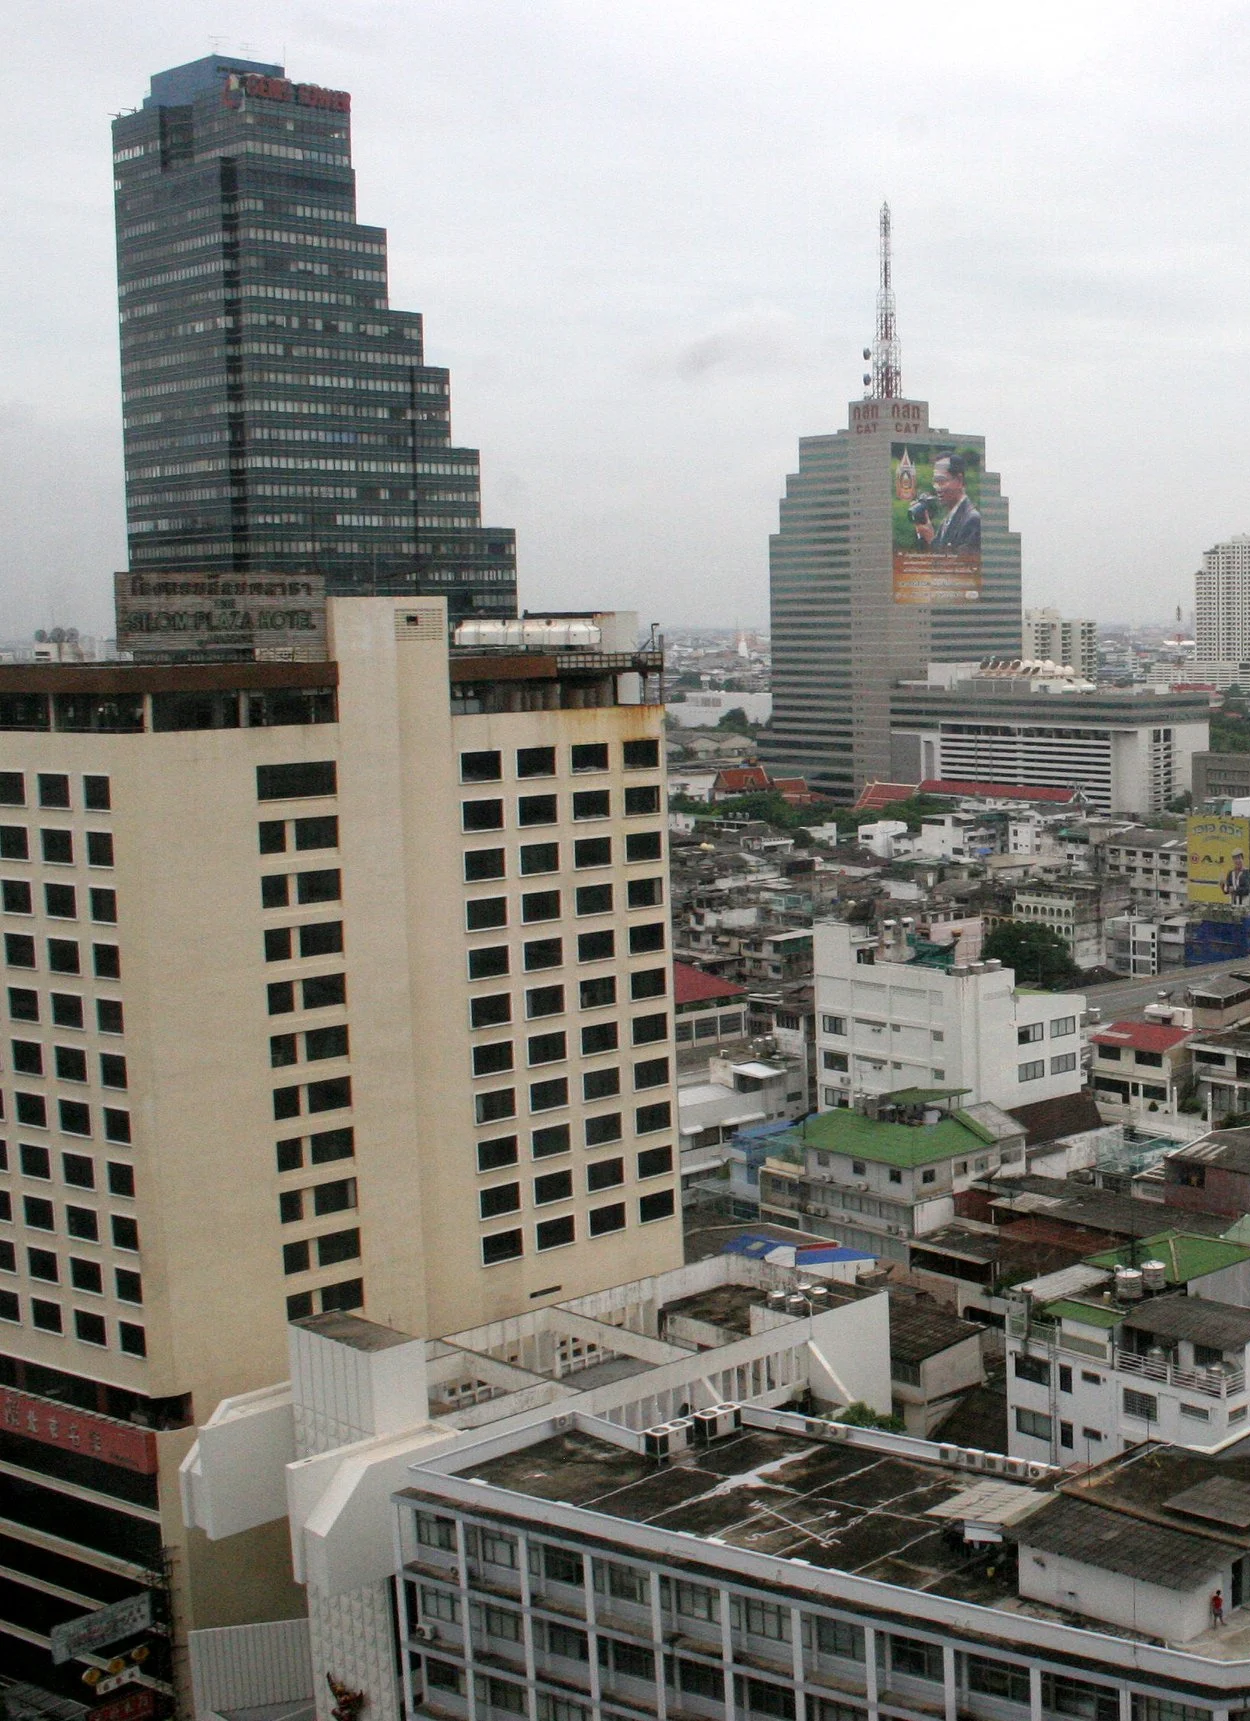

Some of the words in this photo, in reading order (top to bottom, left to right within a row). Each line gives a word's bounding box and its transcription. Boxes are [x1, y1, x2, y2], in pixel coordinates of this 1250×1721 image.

[856, 423, 877, 434] CAT
[895, 422, 921, 434] CAT
[129, 610, 188, 631] SILOM
[194, 610, 254, 630] PLAZA
[258, 610, 317, 630] HOTEL
